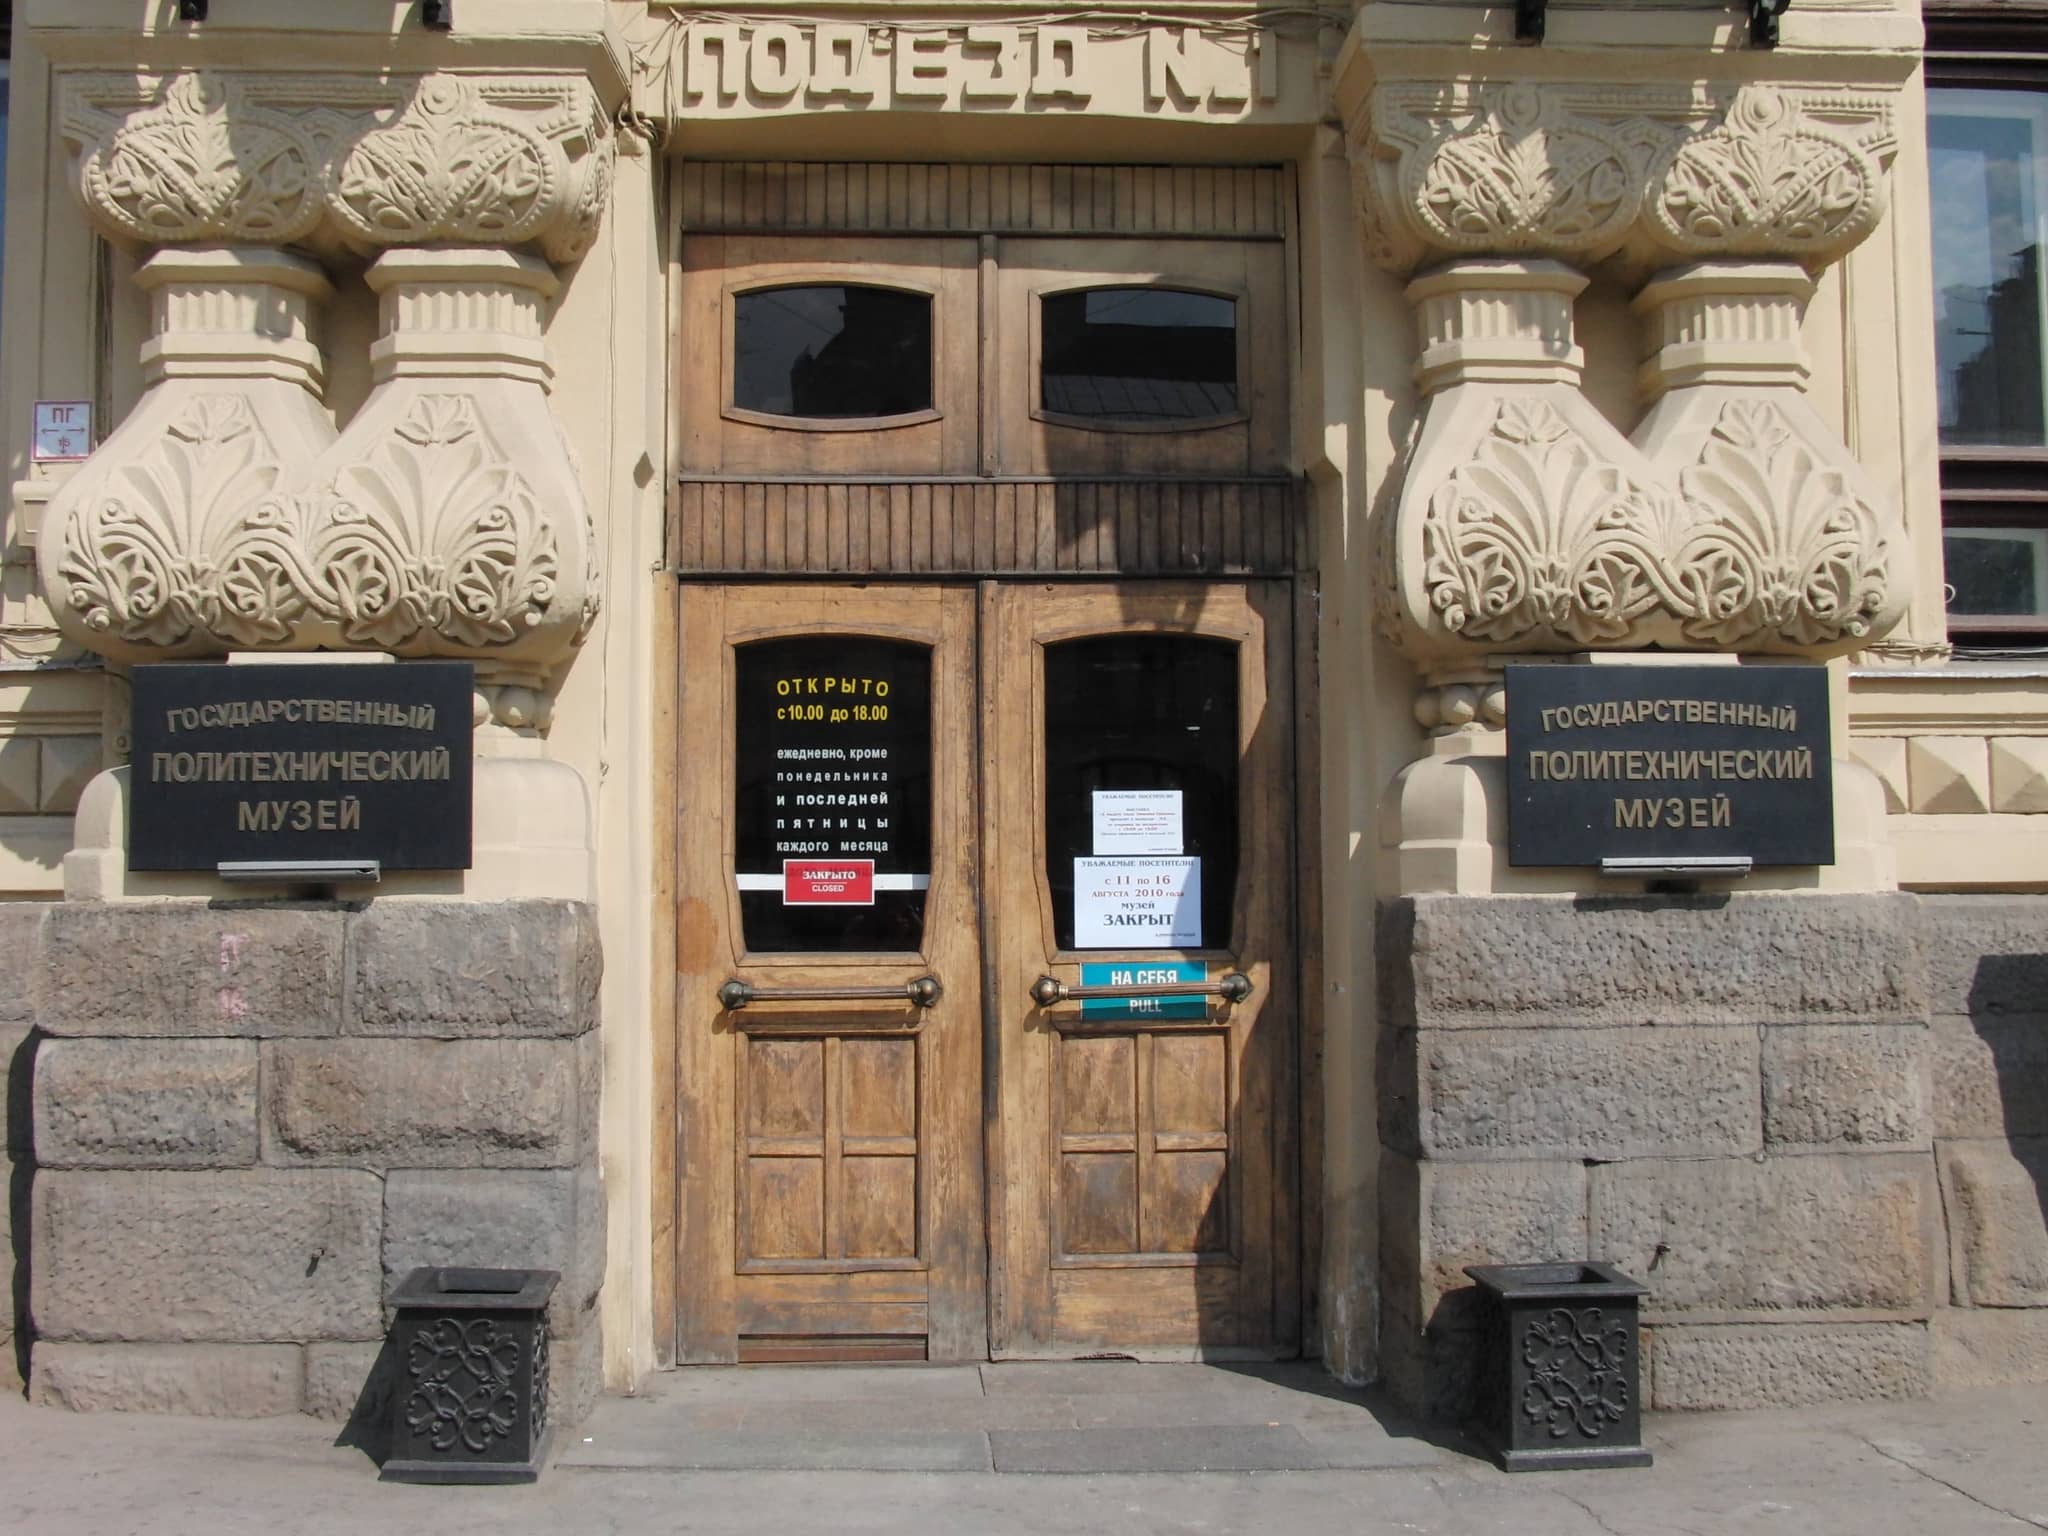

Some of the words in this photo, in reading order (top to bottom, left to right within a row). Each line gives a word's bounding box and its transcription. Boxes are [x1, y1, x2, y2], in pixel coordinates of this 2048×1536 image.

[52, 407, 75, 423] ПГ
[776, 677, 889, 697] ОТКРЫТО
[167, 699, 436, 733] ГОСУДАРСТВЕННЫЙ
[777, 707, 786, 720] с
[788, 704, 824, 720] 10.00
[830, 708, 849, 723] до
[852, 704, 888, 721] 18.00
[1541, 699, 1797, 732] ГОСУДАРСТВЕННЫЙ
[776, 749, 847, 761] ежедневно,
[849, 749, 888, 761] кроме
[151, 746, 450, 783] ПОЛИТЕХНИЧЕСКИЙ
[1529, 746, 1813, 780] ПОЛИТЕХНИЧЕСКИЙ
[776, 771, 889, 783] понедельника
[776, 793, 785, 805] и
[796, 792, 889, 807] последней
[238, 795, 361, 832] МУЗЕЙ
[1614, 793, 1731, 828] МУЗЕЙ
[776, 841, 830, 853] каждого
[840, 841, 889, 853] месяца
[802, 870, 857, 880] ЗАКРЫТО
[1116, 875, 1130, 885] 11
[1156, 875, 1171, 885] 16
[812, 884, 845, 892] CLOSED
[1135, 888, 1164, 897] 2010
[1121, 901, 1155, 911] музей
[1103, 914, 1174, 926] ЗАКРЫТ
[1111, 970, 1132, 985] НА
[1137, 970, 1177, 985] СЕБЯ
[1129, 999, 1162, 1013] PULL
